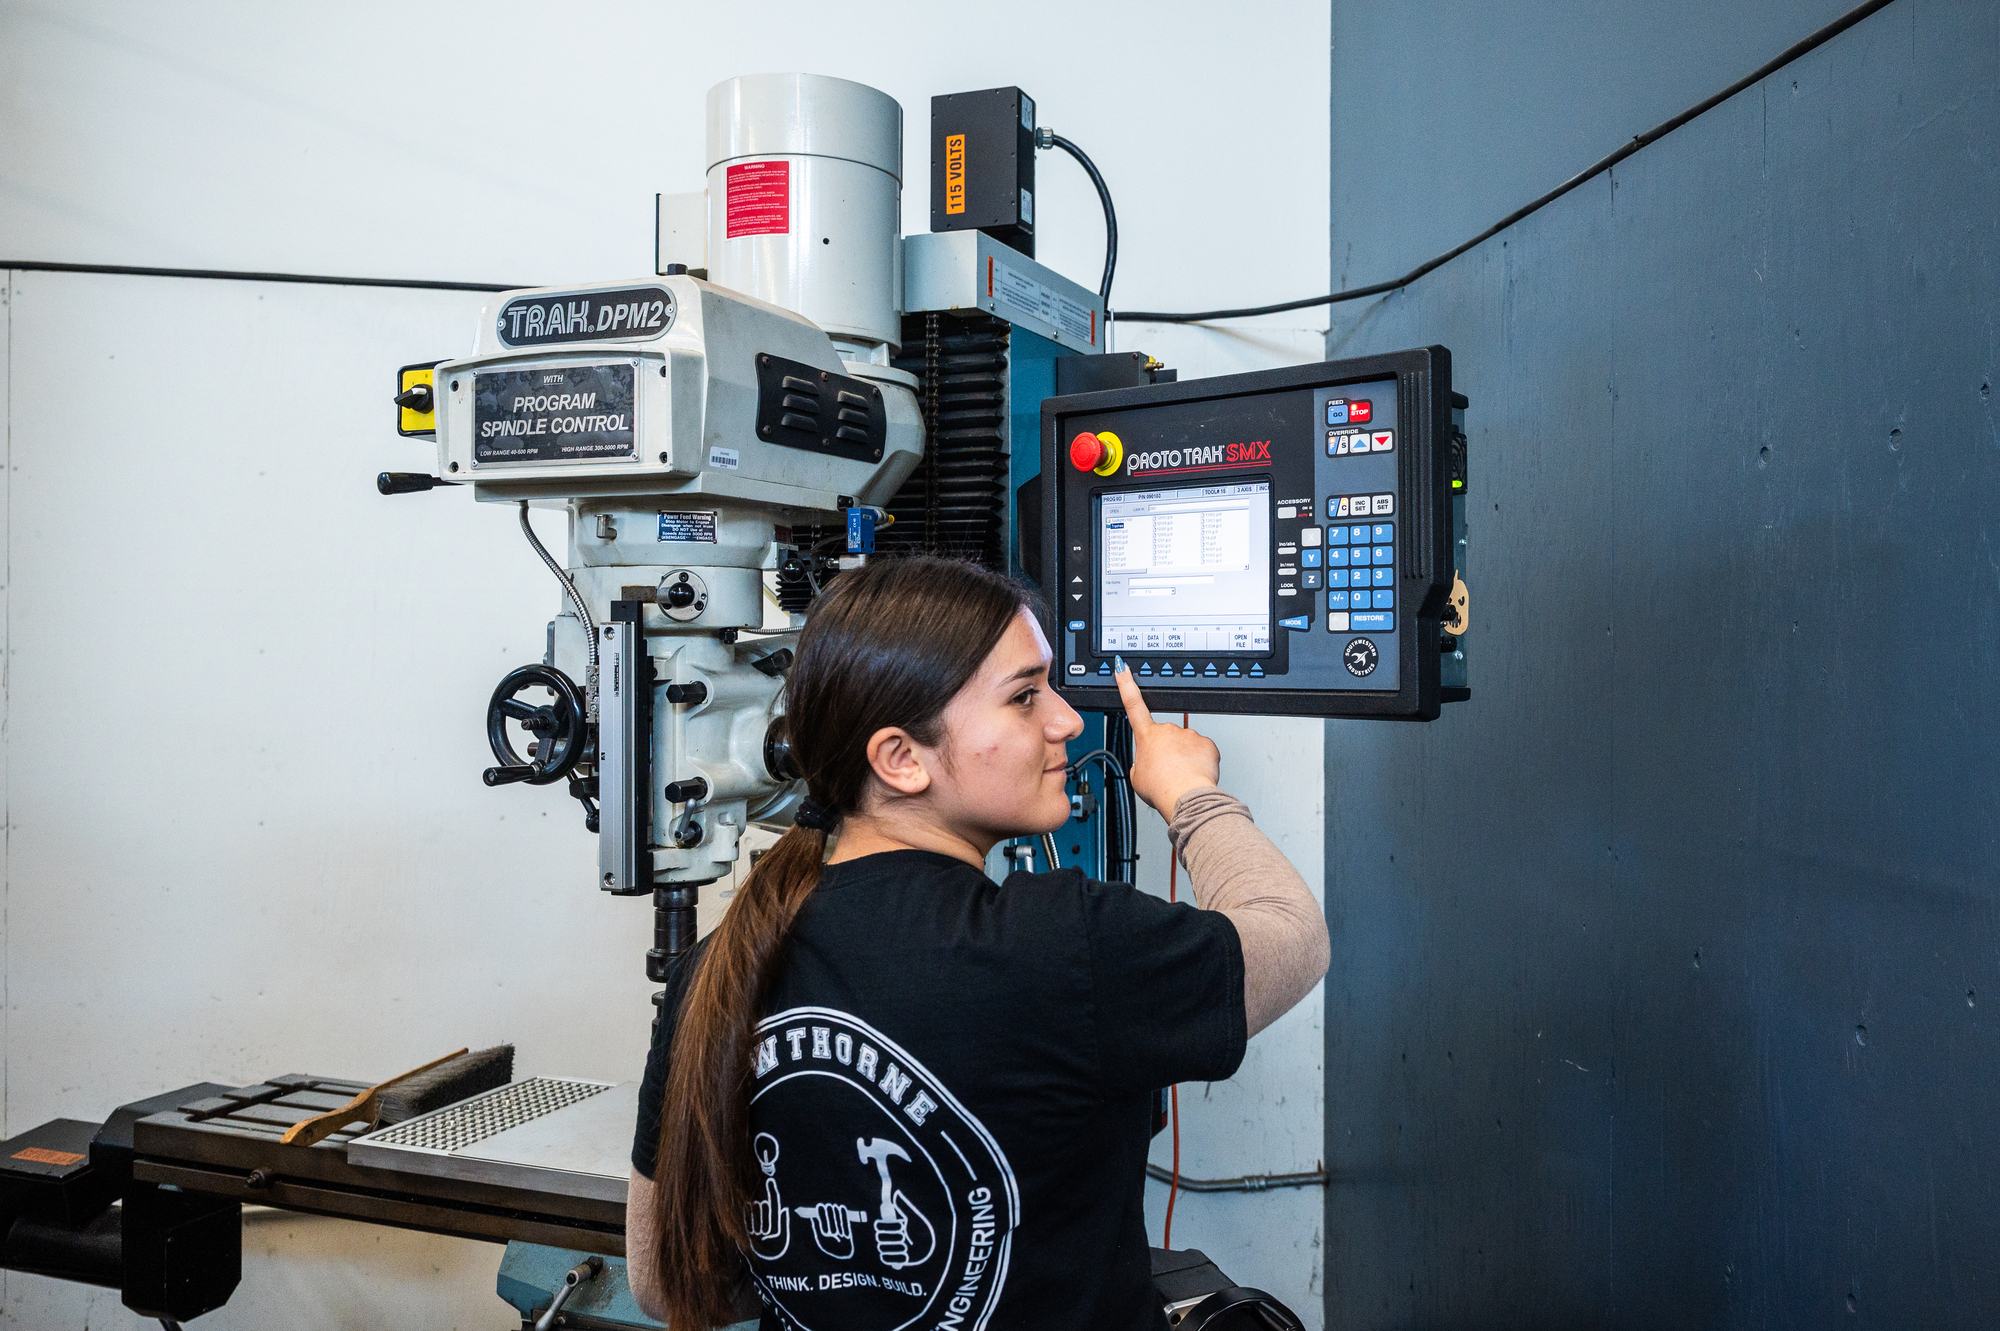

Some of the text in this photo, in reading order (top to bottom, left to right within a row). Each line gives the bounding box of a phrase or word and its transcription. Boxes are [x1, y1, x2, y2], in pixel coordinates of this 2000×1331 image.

[950, 139, 962, 209] 115 VOLTS
[507, 300, 664, 338] TRAK DPM2
[543, 375, 564, 384] WITH
[513, 393, 595, 412] PROGRAM
[481, 414, 629, 437] SPINDLE CONTROL
[1183, 445, 1223, 465] TRAK
[1226, 441, 1271, 462] SMX
[1332, 529, 1339, 537] 7
[1354, 528, 1360, 536] 8
[1375, 527, 1382, 535] 9
[1354, 550, 1360, 558] 5
[1376, 549, 1382, 557] 6
[1354, 572, 1360, 580] 2
[1376, 571, 1383, 579] 3
[1345, 640, 1377, 656] SOUTHWESTERN
[1347, 663, 1375, 676] INDUSTRIES
[934, 1187, 995, 1331] NGINEERING
[766, 1272, 927, 1297] THINK. DESIGN. BUILD.
